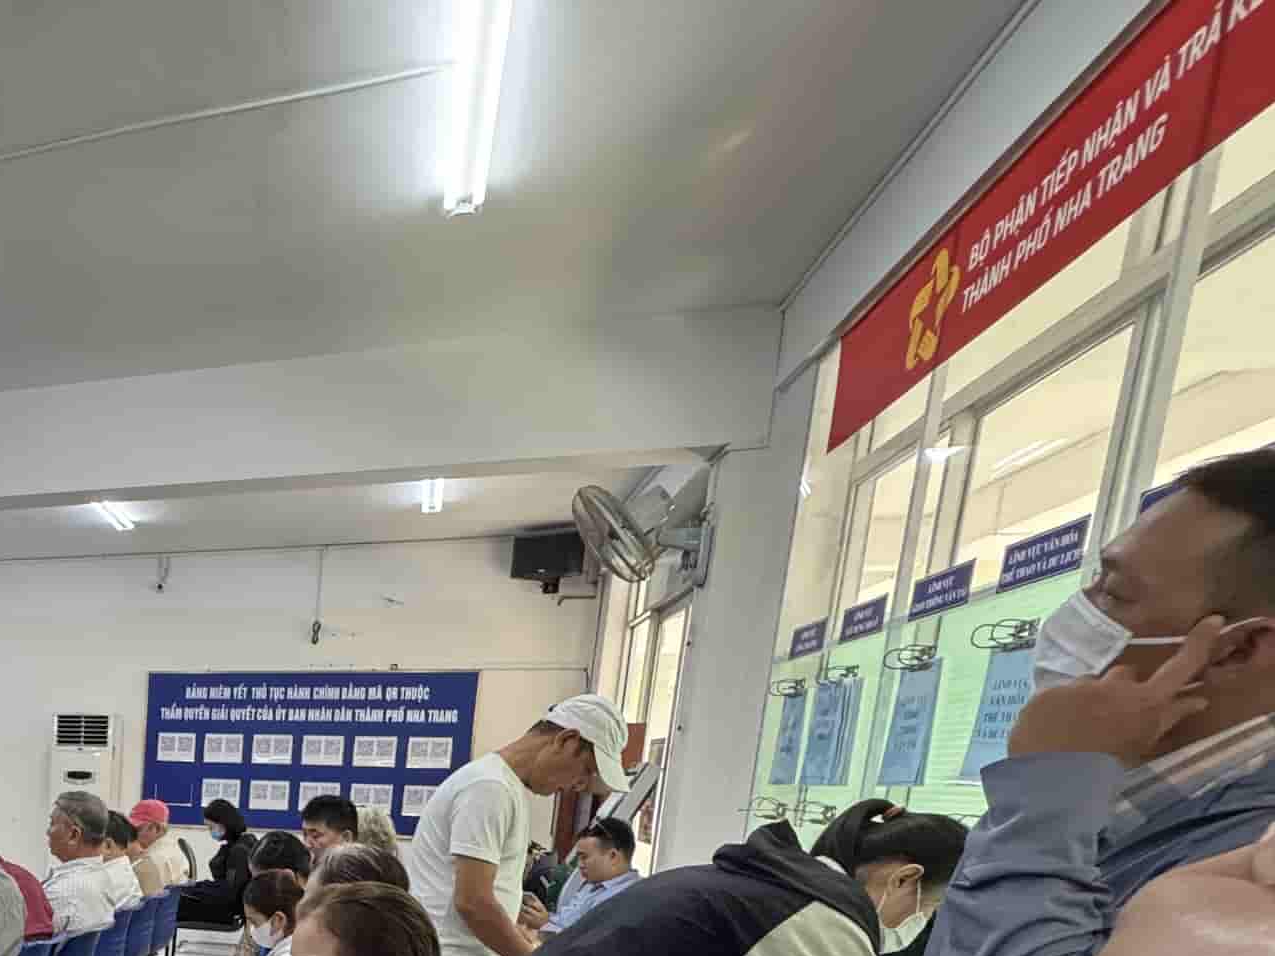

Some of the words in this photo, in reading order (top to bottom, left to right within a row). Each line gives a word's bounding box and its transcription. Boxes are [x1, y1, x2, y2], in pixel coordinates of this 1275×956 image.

[962, 250, 1011, 314] THÀNH
[1014, 208, 1052, 270] PHỐ
[1054, 182, 1093, 237] NHA
[1097, 113, 1169, 199] TRANG
[968, 227, 989, 272] BỘ
[992, 187, 1038, 250] PHẬN
[1040, 146, 1081, 206] TIẾP
[1082, 91, 1140, 170] NHẬN
[1144, 54, 1171, 110] VÀ
[1176, 0, 1222, 80] TRẢ
[406, 709, 425, 722] NHA
[427, 709, 459, 723] TRANG
